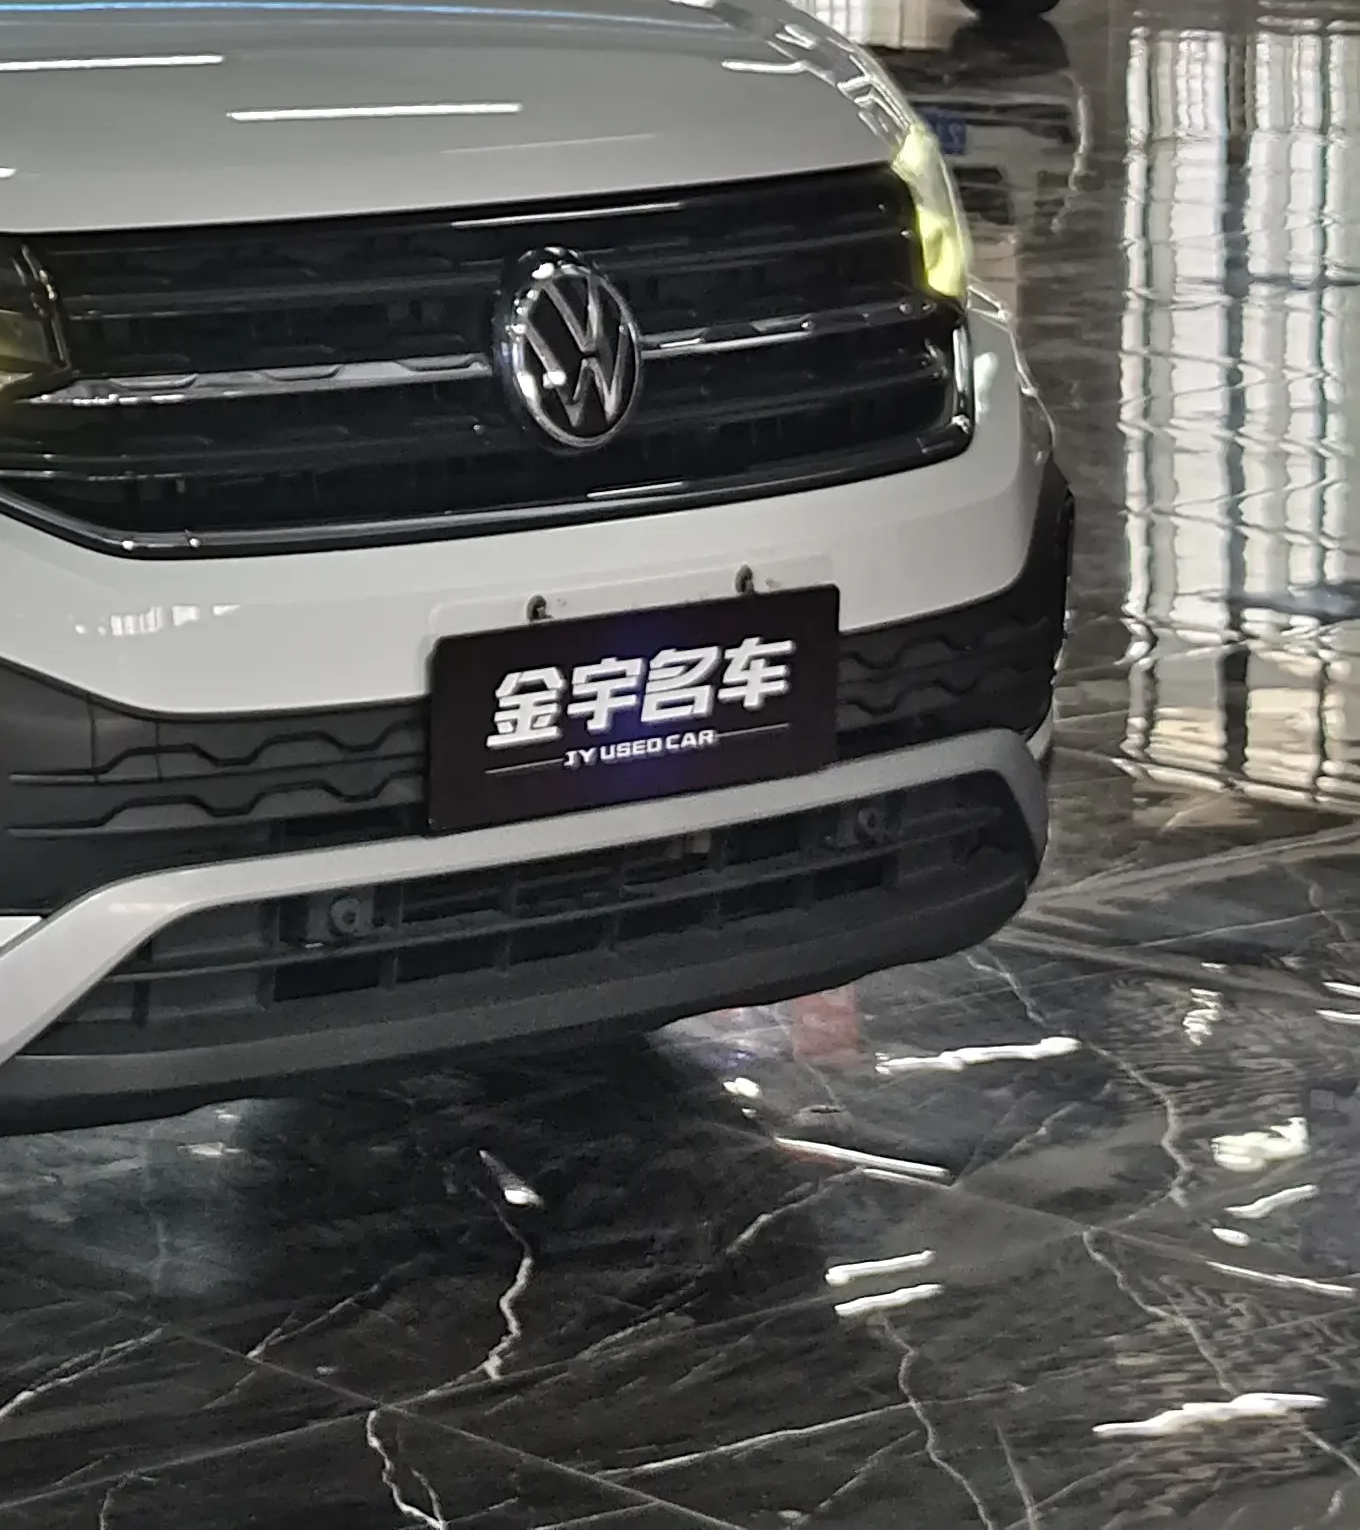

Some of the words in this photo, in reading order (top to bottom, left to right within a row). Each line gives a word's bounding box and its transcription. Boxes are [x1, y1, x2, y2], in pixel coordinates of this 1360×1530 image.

[486, 636, 796, 750] 金宇名车
[600, 738, 663, 762] USED
[665, 730, 716, 752] CAR
